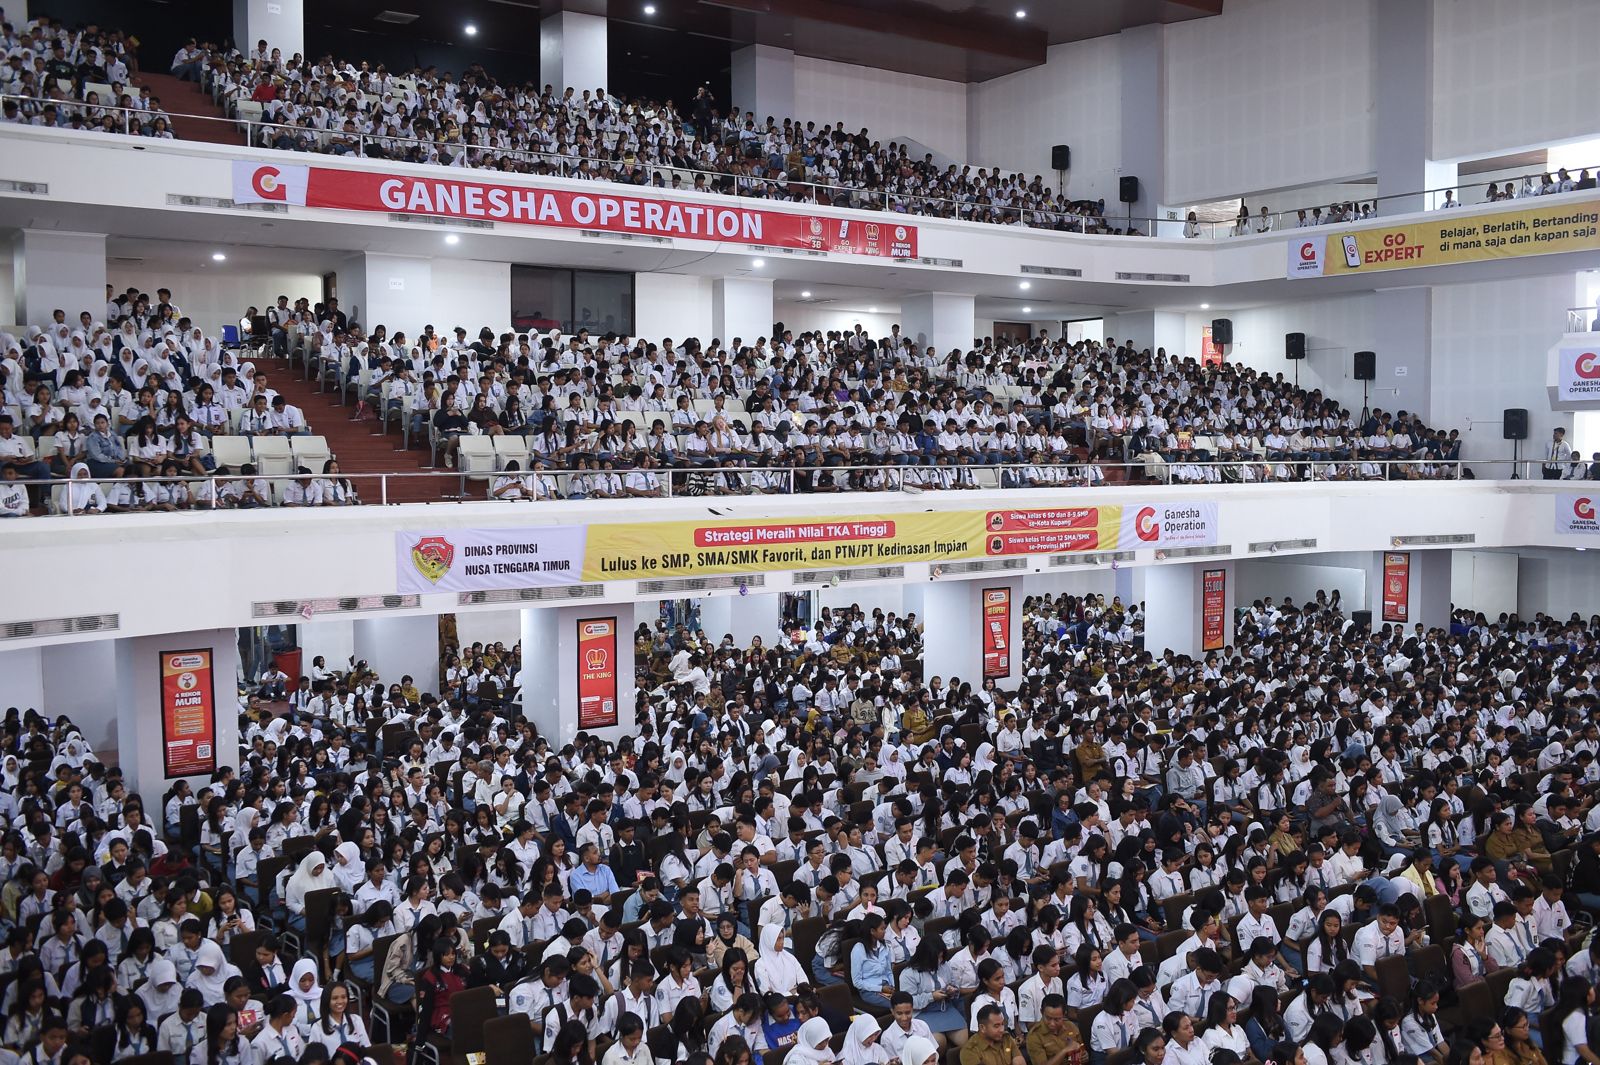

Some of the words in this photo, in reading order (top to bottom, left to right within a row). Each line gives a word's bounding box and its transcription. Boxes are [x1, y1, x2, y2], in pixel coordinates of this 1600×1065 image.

[380, 179, 562, 222] GANESHA
[571, 196, 763, 240] OPERATION
[1440, 226, 1479, 239] Belajar,
[1483, 221, 1529, 234] Berlatih,
[1533, 213, 1599, 228] Bertanding
[1384, 233, 1406, 247] GO
[1440, 242, 1450, 252] di
[1453, 240, 1482, 250] mana
[1485, 236, 1506, 248] saja
[1510, 234, 1530, 244] dan
[1534, 231, 1569, 242] kapan
[1573, 226, 1597, 238] saja
[891, 248, 911, 257] MURI
[1365, 245, 1425, 264] EXPERT
[1165, 508, 1200, 519] Ganesha
[704, 529, 753, 543] Strategi
[756, 527, 796, 540] Meraih
[799, 526, 824, 538] Nilai
[827, 525, 850, 537] TKA
[852, 523, 887, 537] Tinggi
[1164, 520, 1206, 533] Operation
[464, 545, 493, 557] DINAS
[495, 543, 538, 555] PROVINSI
[601, 556, 637, 572] Lulus
[642, 556, 657, 570] ke
[662, 553, 693, 569] SMP,
[698, 550, 759, 567] SMA/SMK
[763, 548, 807, 563] Favorit,
[811, 547, 831, 560] dan
[836, 544, 873, 559] PTN/PT
[878, 542, 930, 556] Kedinasan
[934, 539, 968, 555] Impian
[465, 563, 491, 576] NUSA
[493, 562, 540, 575] TENGGARA
[542, 560, 570, 571] TIMUR
[175, 697, 202, 706] MURI
